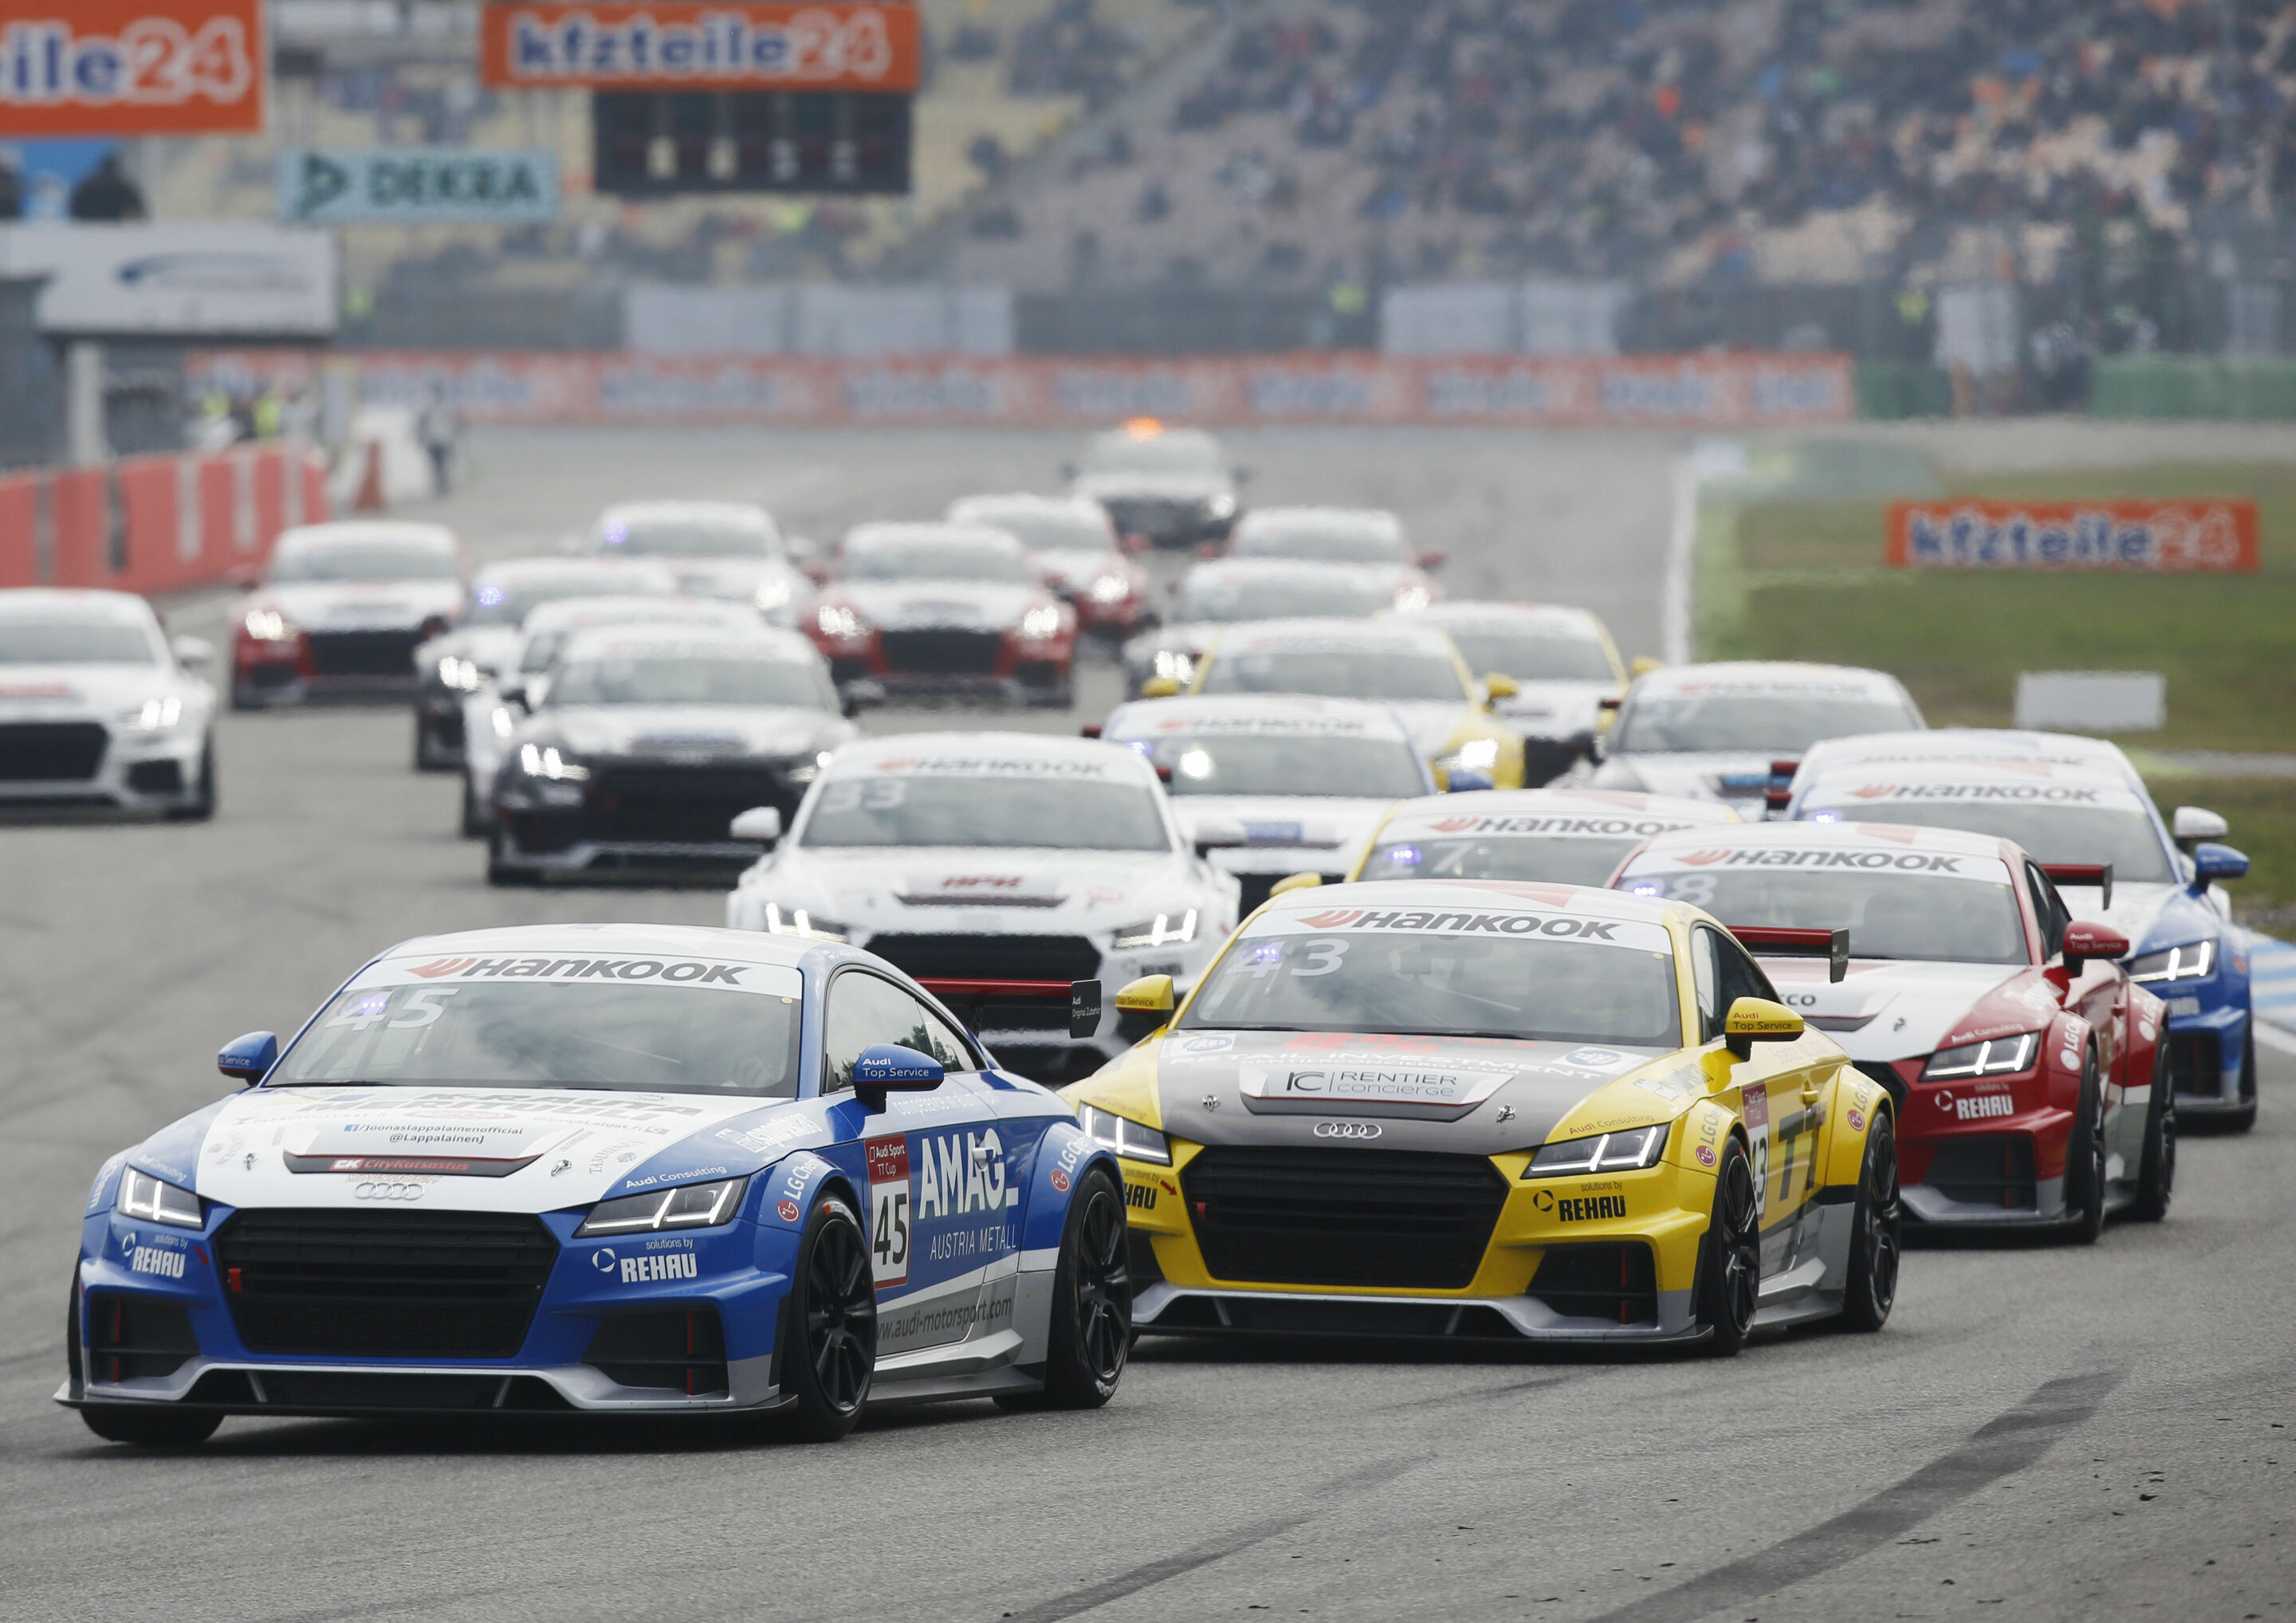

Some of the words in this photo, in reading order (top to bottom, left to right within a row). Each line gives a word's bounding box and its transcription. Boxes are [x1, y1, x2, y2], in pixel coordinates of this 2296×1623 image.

[512, 13, 890, 77] kfzteile24
[0, 16, 250, 105] ile24
[368, 159, 542, 205] DEKRA
[1909, 508, 2239, 563] kfzteile24
[2071, 941, 2088, 950] Top
[1225, 937, 1350, 979] 43
[325, 988, 460, 1032] 45
[1072, 996, 1081, 1005] Audi
[1127, 997, 1154, 1007] Service
[1072, 1008, 1086, 1019] Original
[1733, 1021, 1754, 1030] Top
[1951, 1031, 1975, 1043] Audi
[863, 1068, 887, 1079] Top
[1328, 1052, 1601, 1079] INVESTMENT
[1341, 1071, 1457, 1085] RENTIER
[1337, 1083, 1454, 1097] concierge
[297, 1100, 662, 1122] MERITUULI
[414, 1093, 705, 1116] K-RAUTA
[1956, 1094, 2014, 1120] REHAU
[1570, 1124, 1595, 1135] Audi
[1597, 1114, 1654, 1128] Consulting
[389, 1133, 485, 1144] @LappalainenJ
[876, 1146, 889, 1158] Audi
[889, 1143, 906, 1156] Sport
[364, 1159, 470, 1172] CityKatsastus
[878, 1165, 885, 1176] TT
[885, 1165, 897, 1177] Cup
[626, 1174, 657, 1189] Audi
[659, 1164, 727, 1182] Consulting
[1581, 1182, 1613, 1192] solutions
[1614, 1181, 1622, 1190] by
[784, 1177, 805, 1201] LG
[1559, 1196, 1626, 1222] REHAU
[874, 1193, 907, 1266] 45
[180, 1236, 188, 1249] by
[646, 1239, 682, 1250] solutions
[682, 1236, 694, 1248] by
[930, 1230, 975, 1260] AUSTRIA
[980, 1224, 1016, 1256] METALL
[132, 1246, 186, 1279] REHAU
[620, 1252, 698, 1283] REHAU
